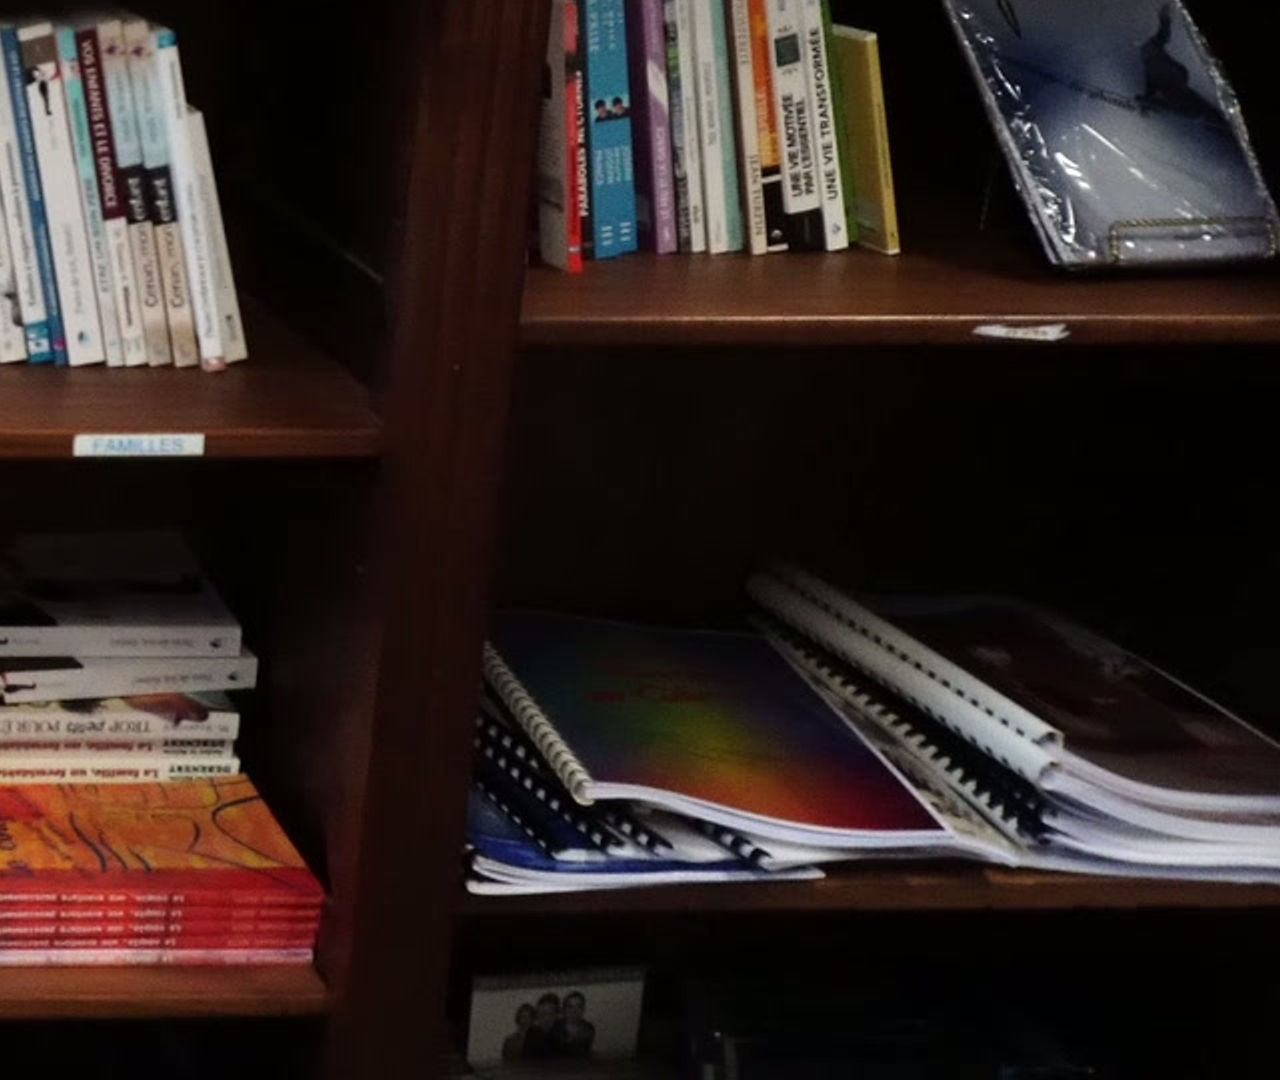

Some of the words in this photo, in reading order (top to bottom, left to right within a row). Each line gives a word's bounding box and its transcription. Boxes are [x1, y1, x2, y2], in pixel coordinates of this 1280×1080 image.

[807, 27, 831, 139] TRANSFORMÉE
[781, 93, 798, 149] MOTIVÉE
[795, 99, 811, 167] L'ESSENTIEL
[786, 149, 800, 168] VIE
[819, 141, 835, 166] VIE
[788, 170, 803, 198] UNE
[800, 168, 815, 195] PAR
[823, 168, 839, 200] UNE
[92, 437, 184, 453] FAMILLES
